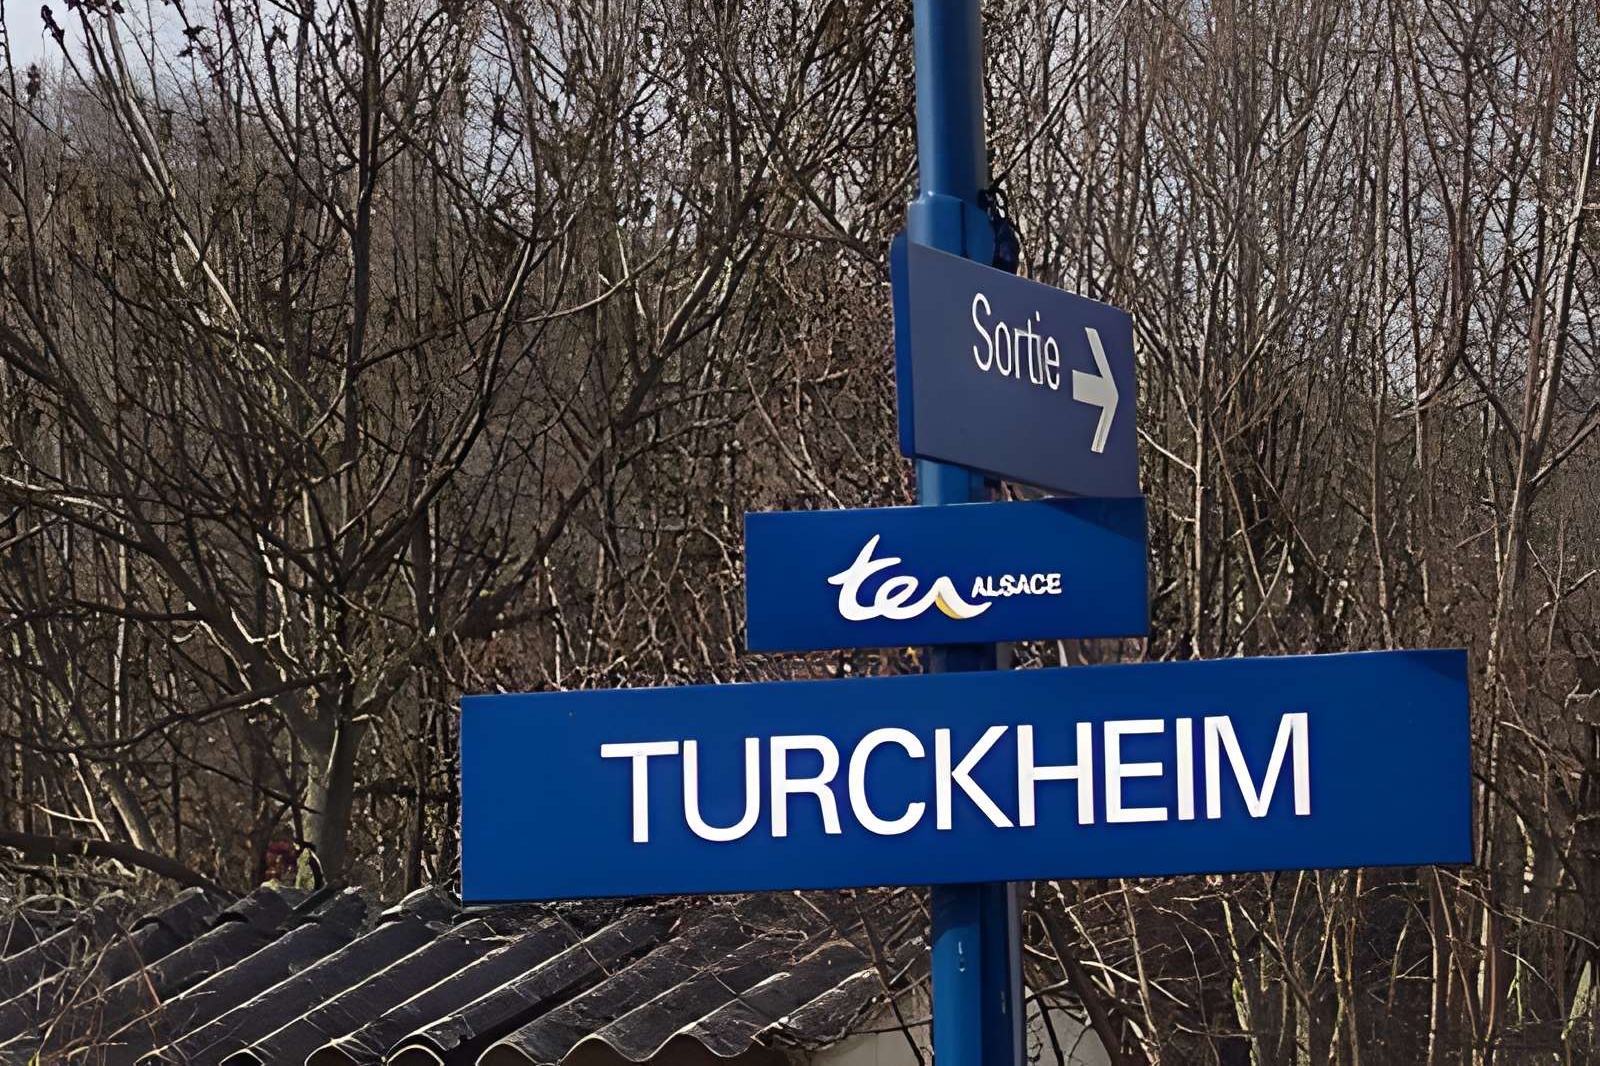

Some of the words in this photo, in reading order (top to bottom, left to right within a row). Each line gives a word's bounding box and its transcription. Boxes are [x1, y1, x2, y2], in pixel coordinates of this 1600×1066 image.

[972, 292, 1060, 390] Sortie
[971, 572, 1062, 598] ALSACE
[600, 712, 1311, 843] TURCKHEIM
